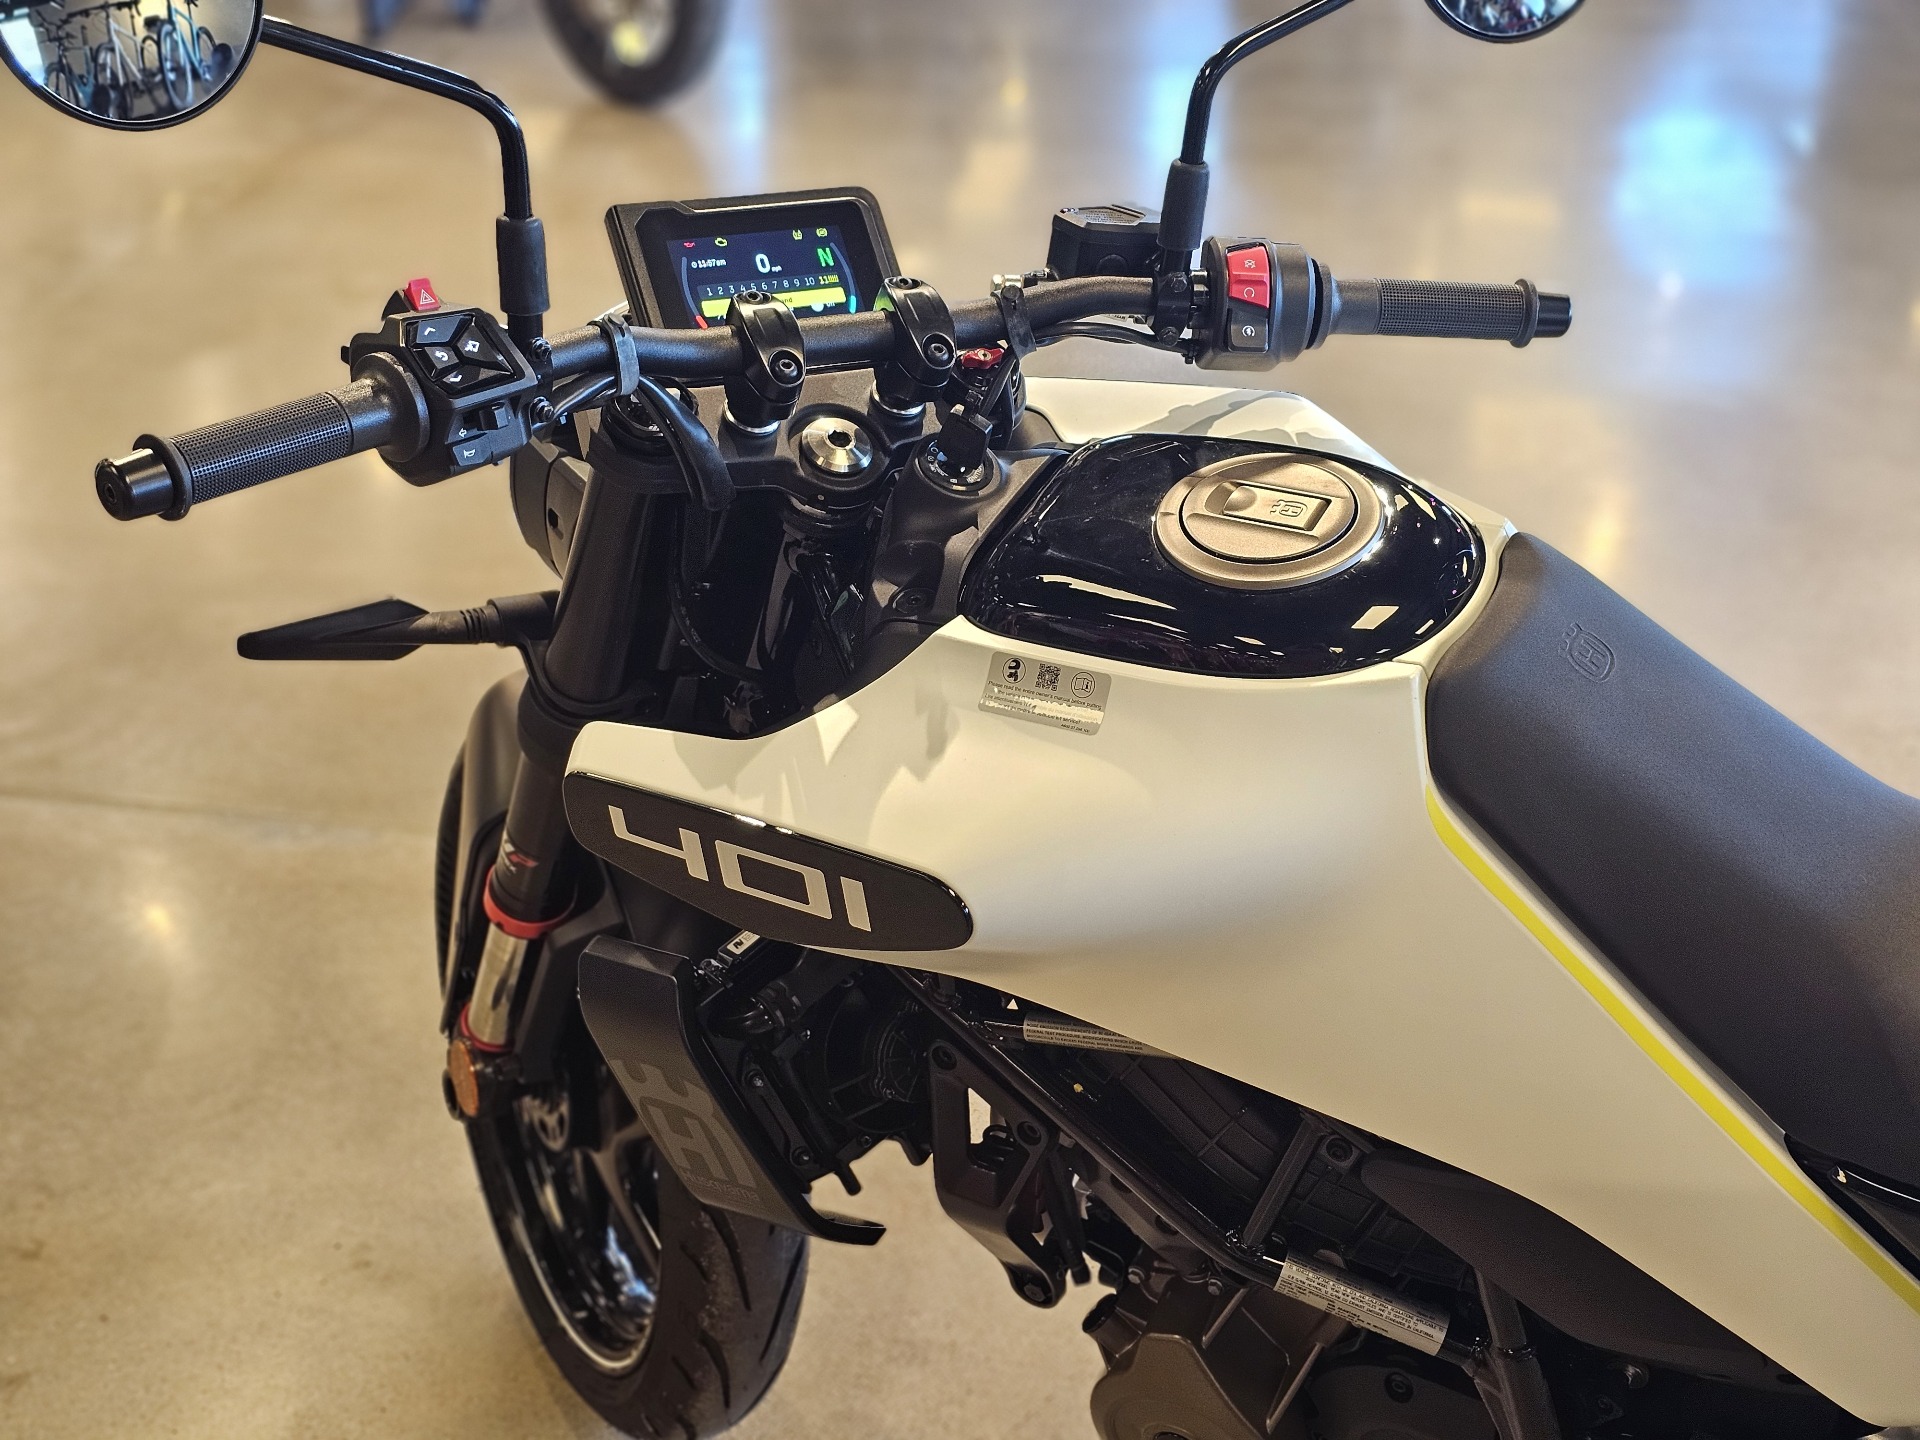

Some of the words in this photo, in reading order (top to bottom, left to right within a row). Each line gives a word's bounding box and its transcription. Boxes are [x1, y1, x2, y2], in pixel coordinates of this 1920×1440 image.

[755, 254, 771, 274] 0
[817, 247, 835, 267] N
[706, 288, 713, 296] 1
[718, 286, 724, 295] 2
[728, 285, 735, 294] 3
[740, 284, 746, 292] 4
[750, 282, 756, 291] 5
[762, 282, 768, 290] 6
[772, 280, 778, 289] 7
[783, 280, 790, 288] 8
[794, 278, 800, 287] 9
[804, 276, 815, 286] 10
[988, 680, 1003, 688] Please
[1086, 702, 1102, 710] putting
[608, 804, 872, 932] 401
[1081, 1034, 1113, 1042] MODIFICATIONS
[1315, 1280, 1328, 1288] MODEL
[1330, 1286, 1340, 1294] YEAR
[1350, 1294, 1376, 1309] MOTORCYCLES
[1392, 1312, 1411, 1324] CERTIFIED
[1348, 1299, 1365, 1310] EXHAUST
[1365, 1307, 1383, 1317] EMISSION
[1384, 1314, 1406, 1327] STANDARDS
[1367, 1296, 1389, 1309] CALIFORNIA
[1389, 1306, 1414, 1319] REGULATIONS
[1415, 1316, 1438, 1329] APPLICABLE
